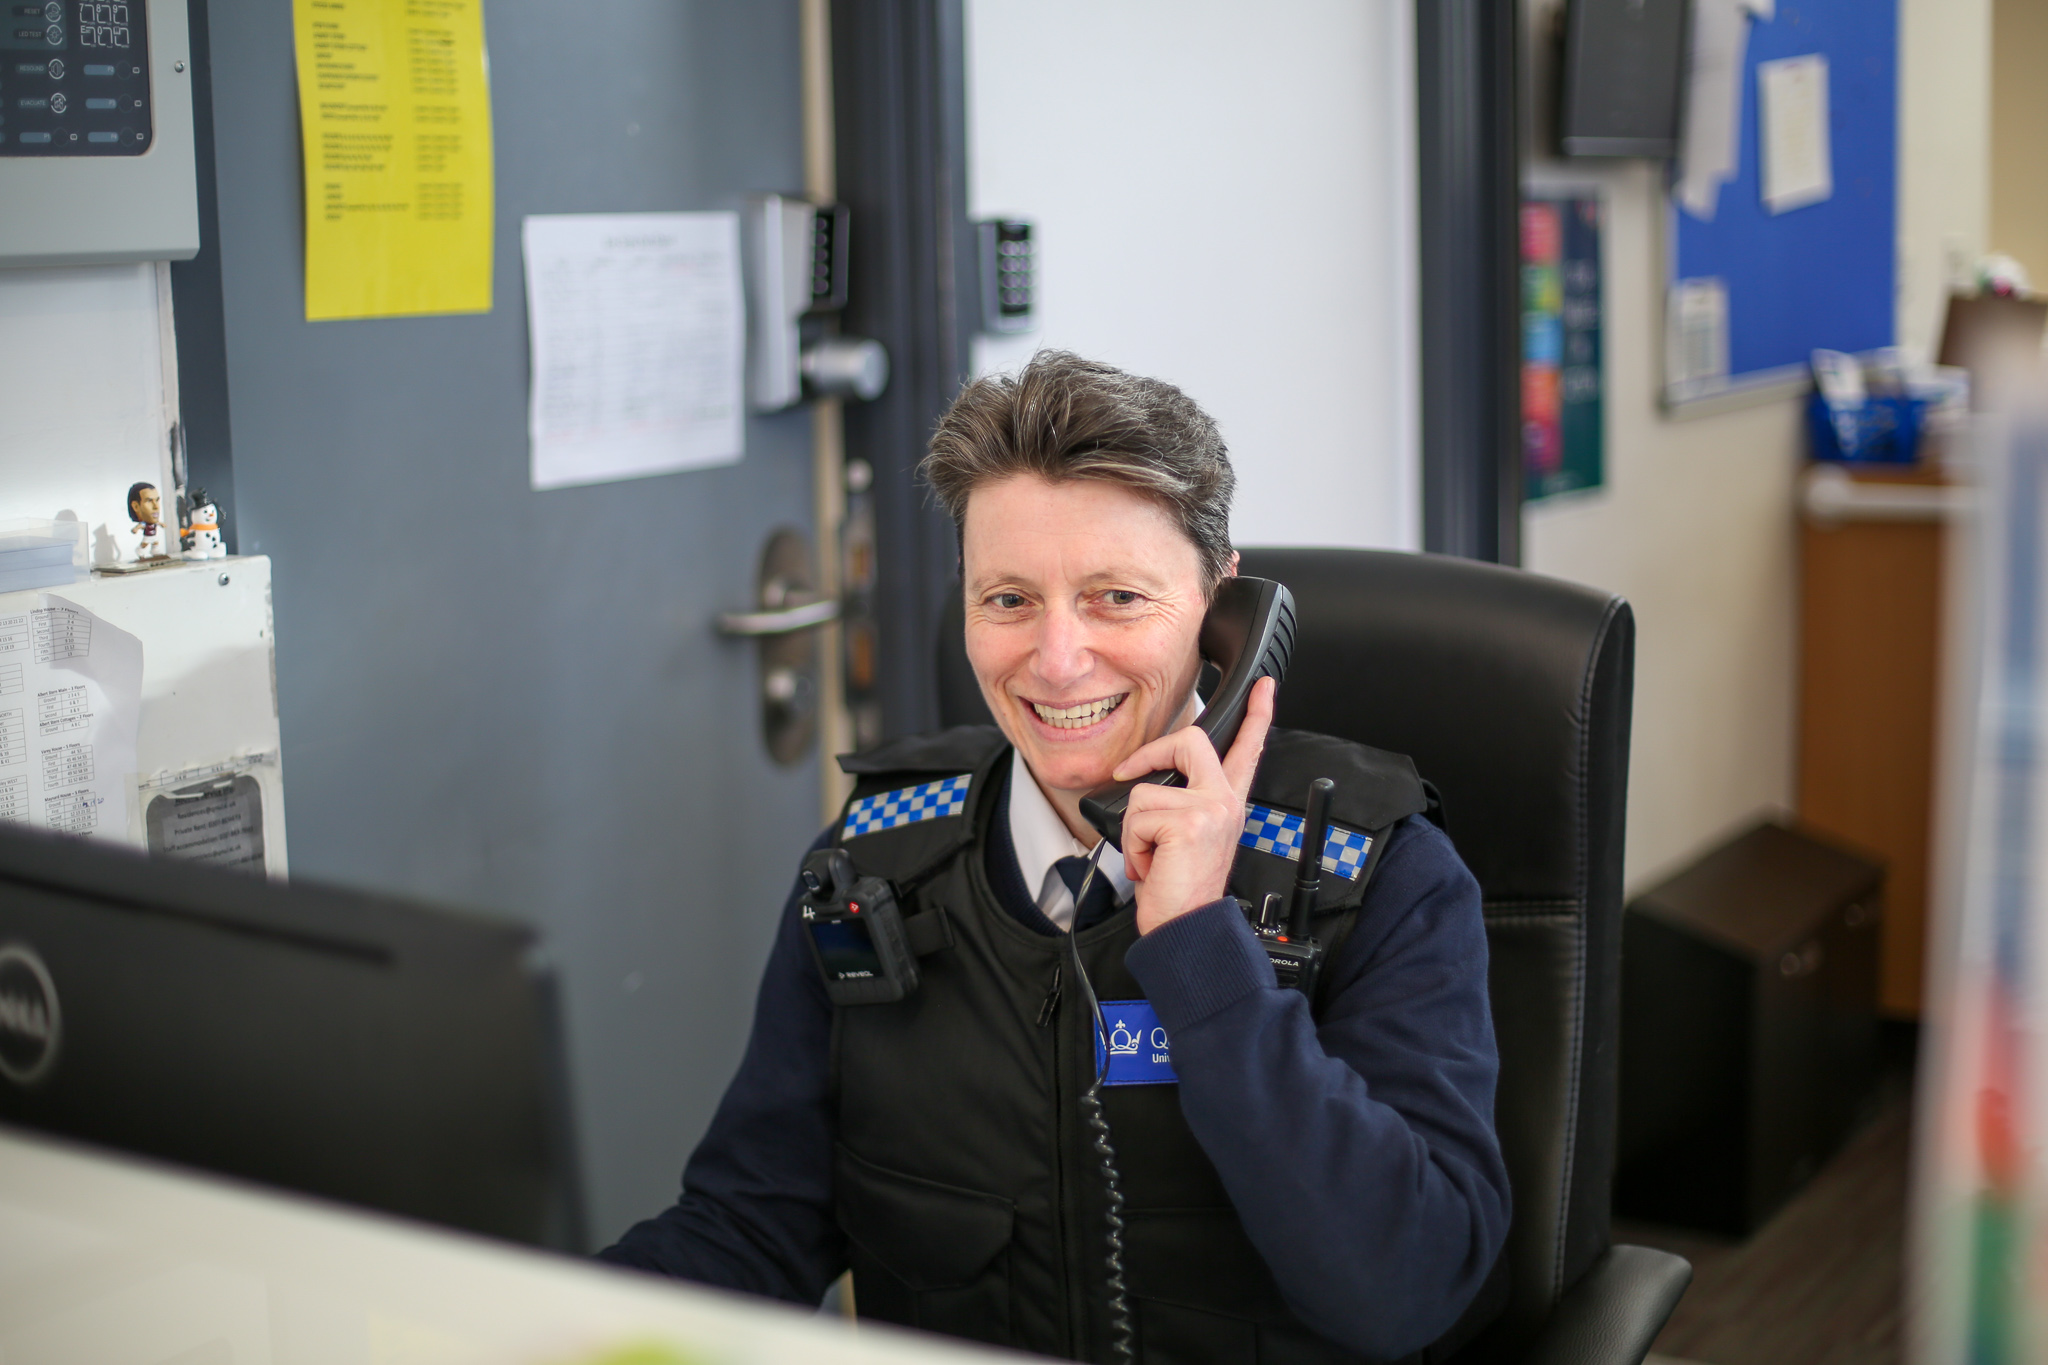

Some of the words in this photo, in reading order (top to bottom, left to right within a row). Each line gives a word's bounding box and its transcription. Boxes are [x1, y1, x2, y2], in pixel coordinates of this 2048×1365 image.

[79, 3, 85, 13] 7
[96, 4, 101, 13] 8
[113, 5, 118, 14] 9
[48, 801, 61, 809] Ground
